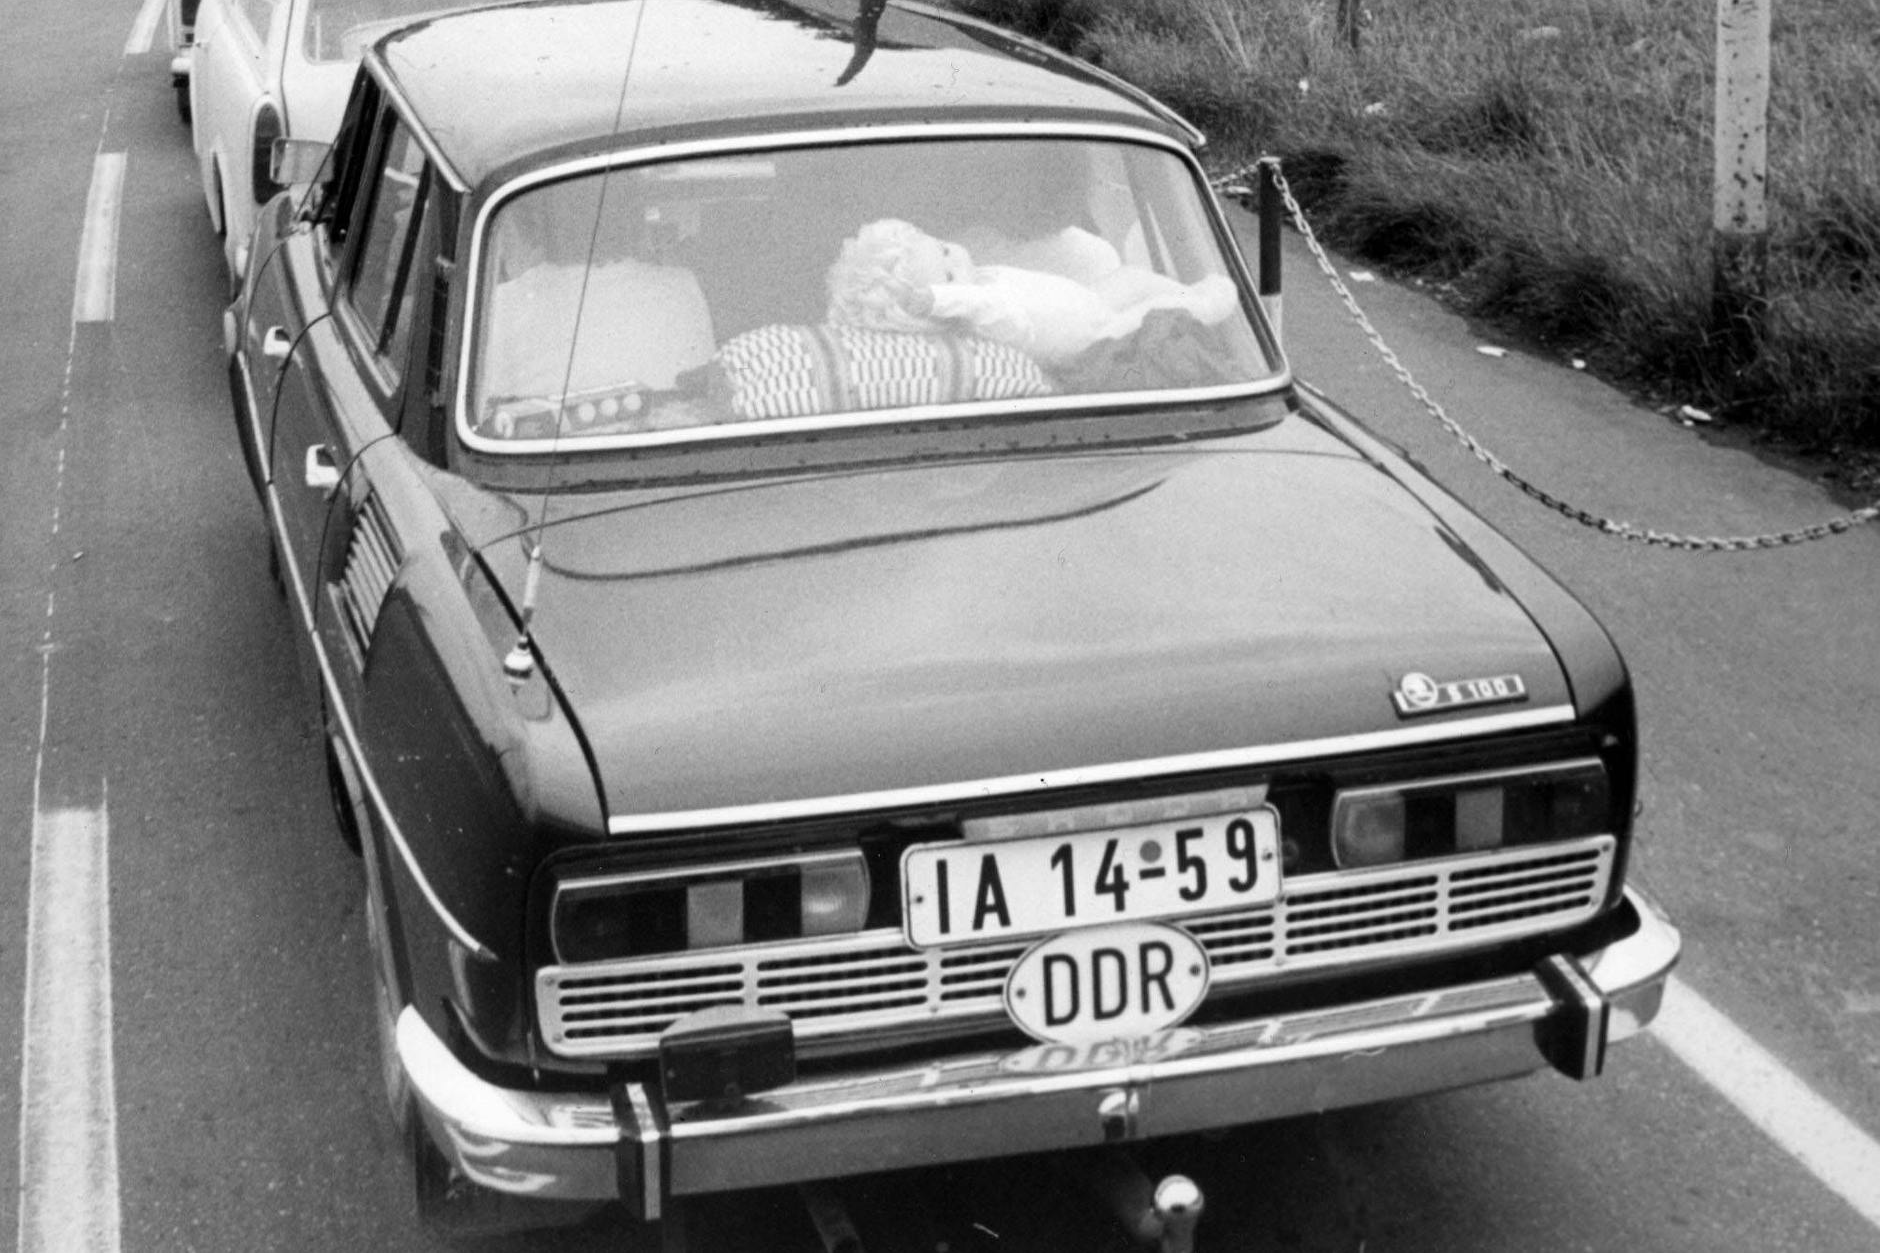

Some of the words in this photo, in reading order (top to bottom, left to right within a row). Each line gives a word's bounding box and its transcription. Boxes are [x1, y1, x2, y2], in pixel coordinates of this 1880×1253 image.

[936, 853, 1012, 935] IA
[1050, 818, 1259, 918] 14-59
[1042, 941, 1175, 1027] DDR
